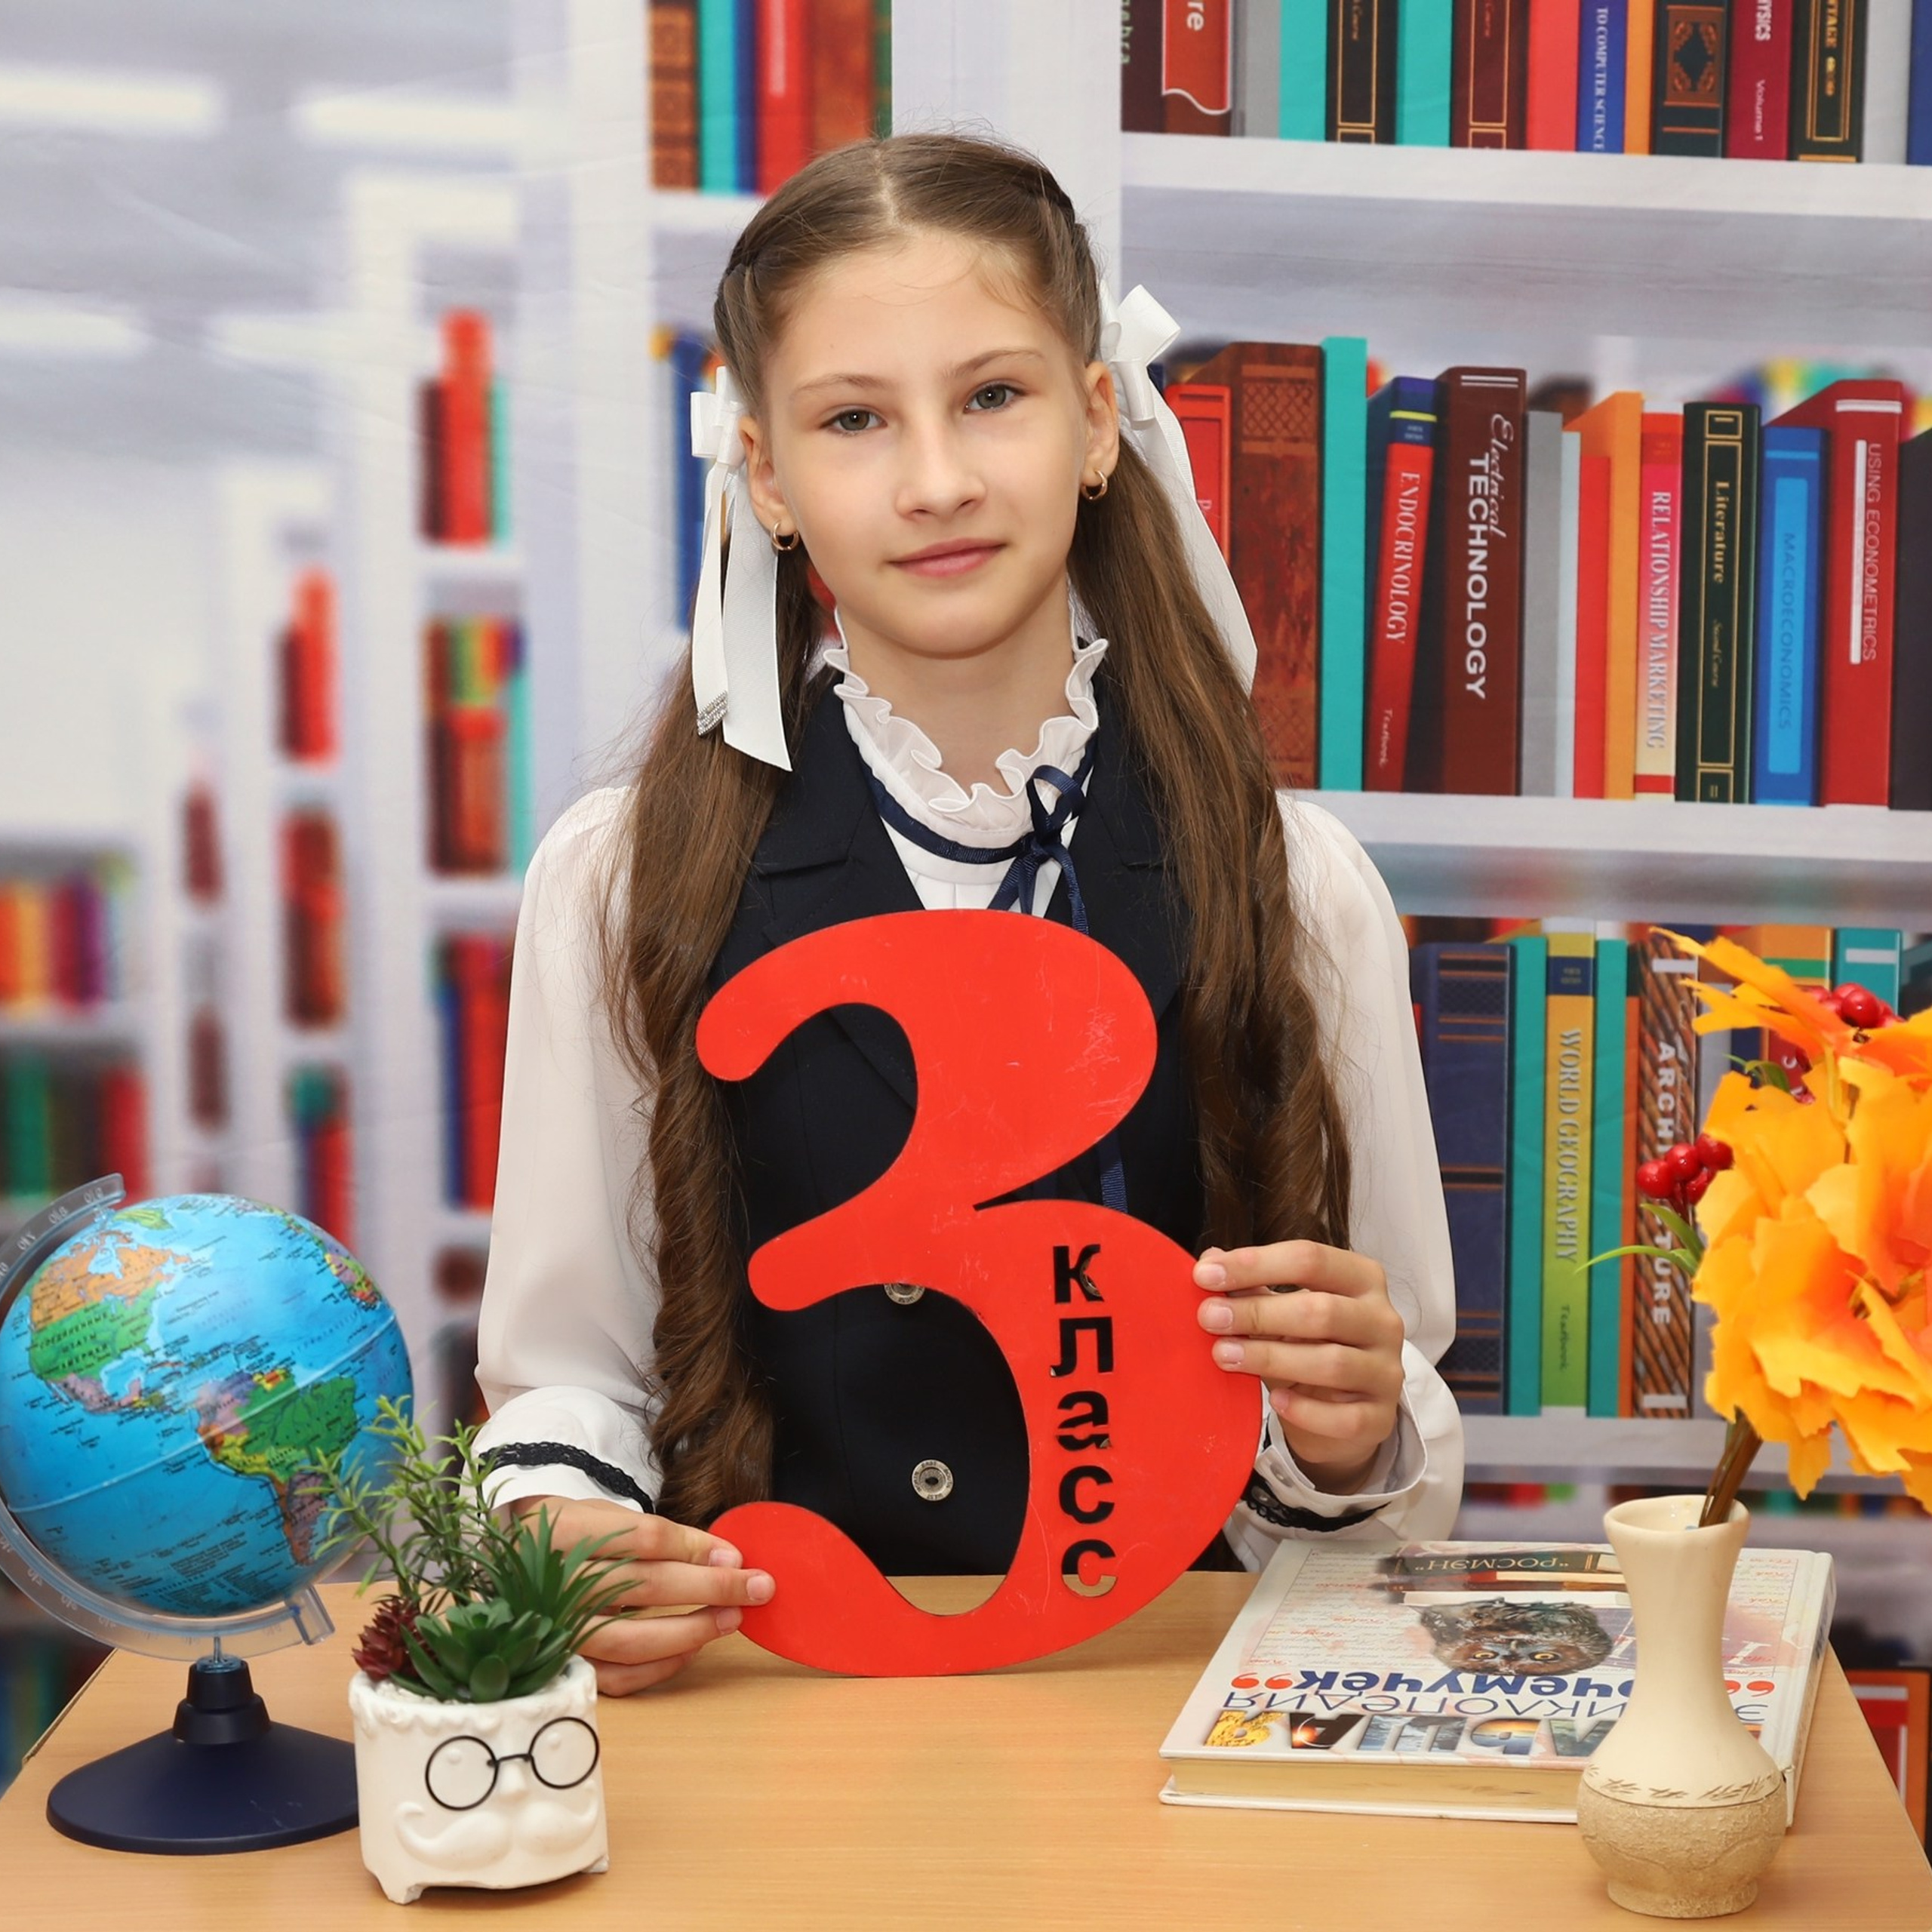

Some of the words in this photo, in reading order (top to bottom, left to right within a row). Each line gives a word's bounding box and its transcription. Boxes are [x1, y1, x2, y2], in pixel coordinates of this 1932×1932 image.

[1186, 0, 1205, 31] re
[1594, 26, 1608, 97] COMPUTER
[1596, 7, 1609, 25] TO
[1753, 78, 1766, 133] Volume
[1866, 443, 1882, 503] USING
[1386, 471, 1422, 645] ENDOCRINOLOGY
[1465, 453, 1490, 700] TECHNOLOGY
[1649, 491, 1672, 629] RELATIONSHIP
[1712, 480, 1730, 584] Literature
[1862, 508, 1881, 662] ECONOMETRICS
[1777, 532, 1796, 731] MACROECONOMICS
[1646, 633, 1669, 749] MARKETING
[1558, 1028, 1582, 1115] WORLD
[1555, 1118, 1580, 1263] GEOGRAPHY
[696, 909, 1263, 1678] 3
